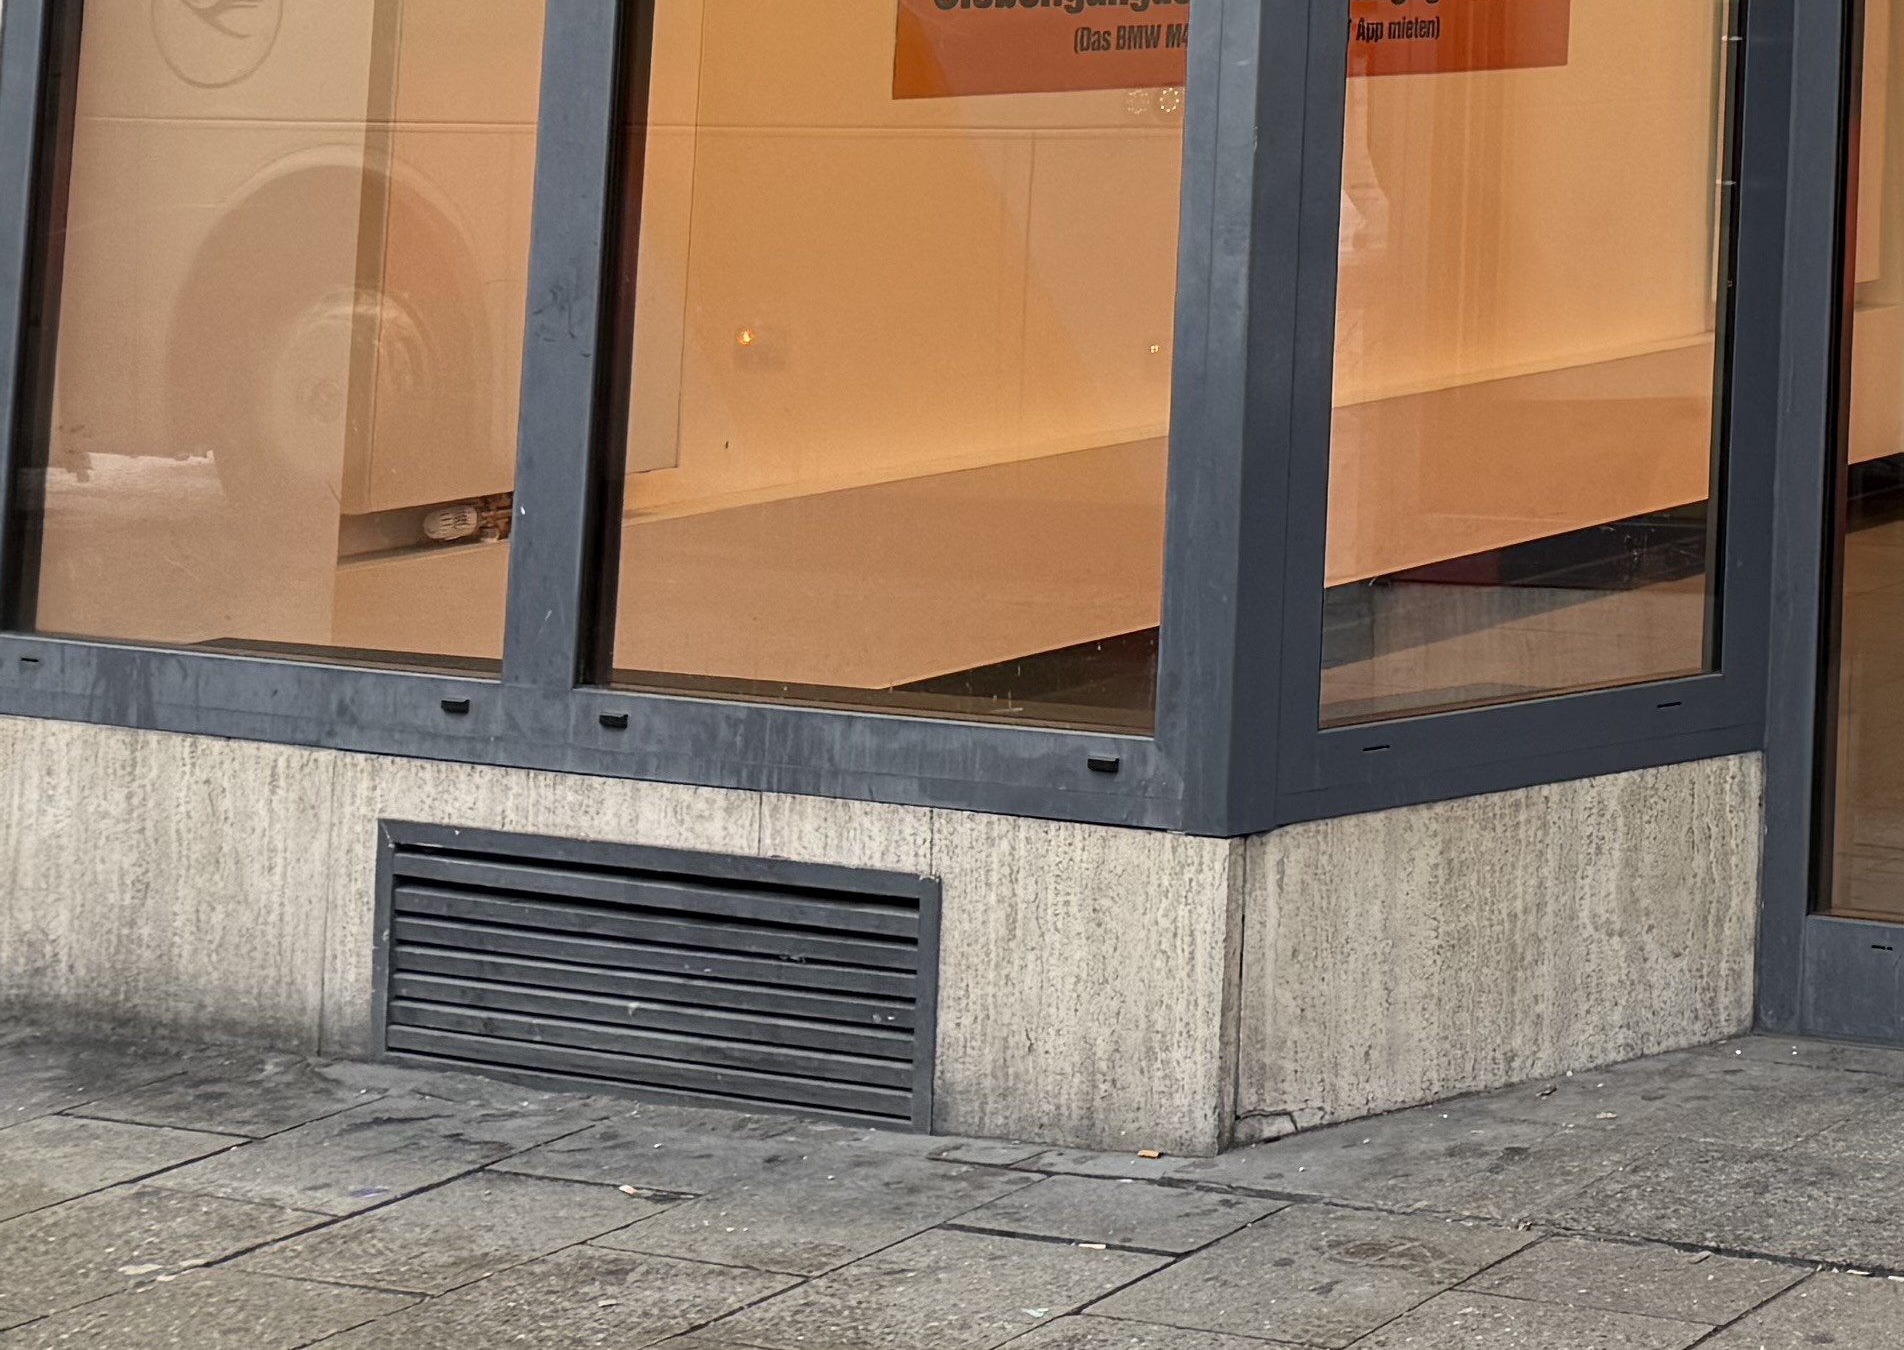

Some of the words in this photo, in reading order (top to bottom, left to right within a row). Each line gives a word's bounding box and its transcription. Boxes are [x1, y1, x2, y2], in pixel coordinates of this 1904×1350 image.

[1074, 26, 1112, 54] (Das
[1115, 24, 1161, 51] BMW
[1356, 17, 1384, 44] App
[1387, 16, 1441, 41] mieten)
